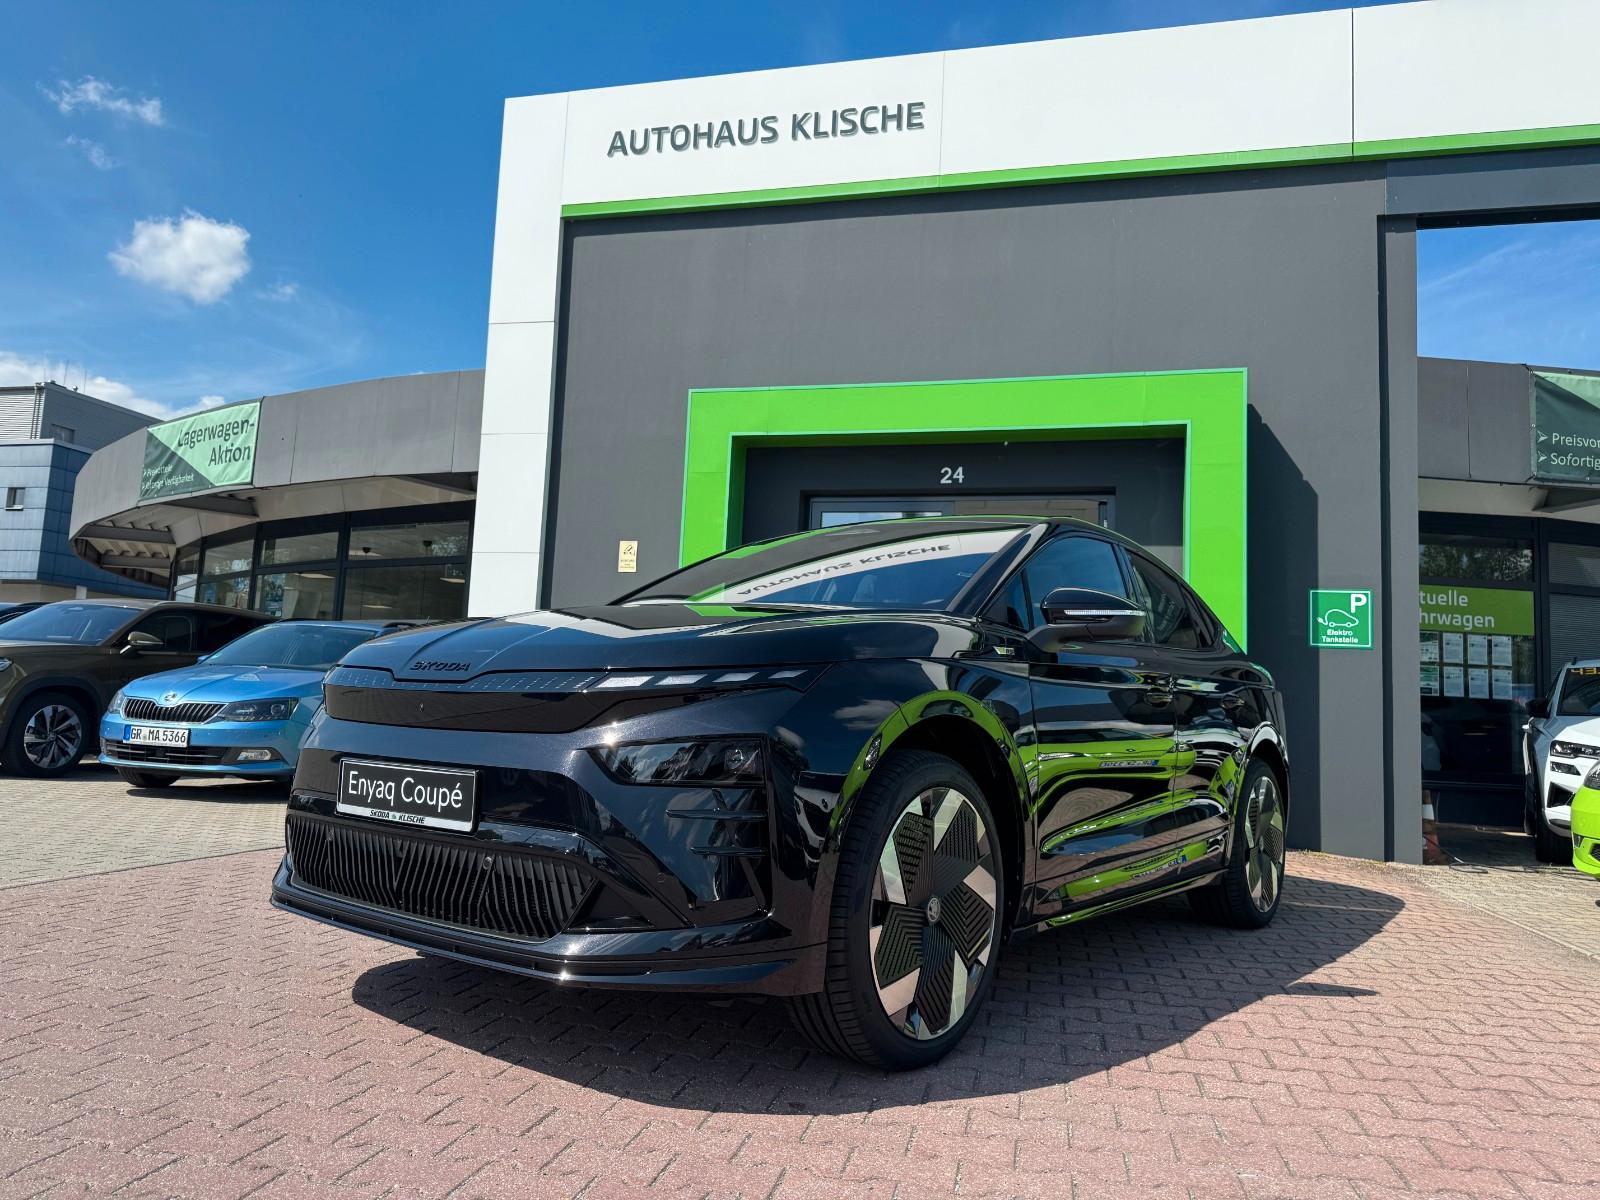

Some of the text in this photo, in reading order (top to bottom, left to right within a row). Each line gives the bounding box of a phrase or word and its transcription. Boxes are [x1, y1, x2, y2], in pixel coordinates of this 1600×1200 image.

[606, 101, 926, 158] AUTOHAUS KLISCHE
[177, 418, 255, 449] Lagerwagen-
[1552, 432, 1600, 448] Preisvor
[207, 443, 252, 467] Aktion
[1550, 452, 1600, 471] Sofortig
[940, 466, 965, 484] 24
[1350, 593, 1367, 614] P
[1321, 635, 1359, 644] Tankstelle
[1327, 628, 1354, 636] Elektro
[130, 728, 186, 743] GR MA 5366
[348, 770, 463, 813] Enyaq Coupé
